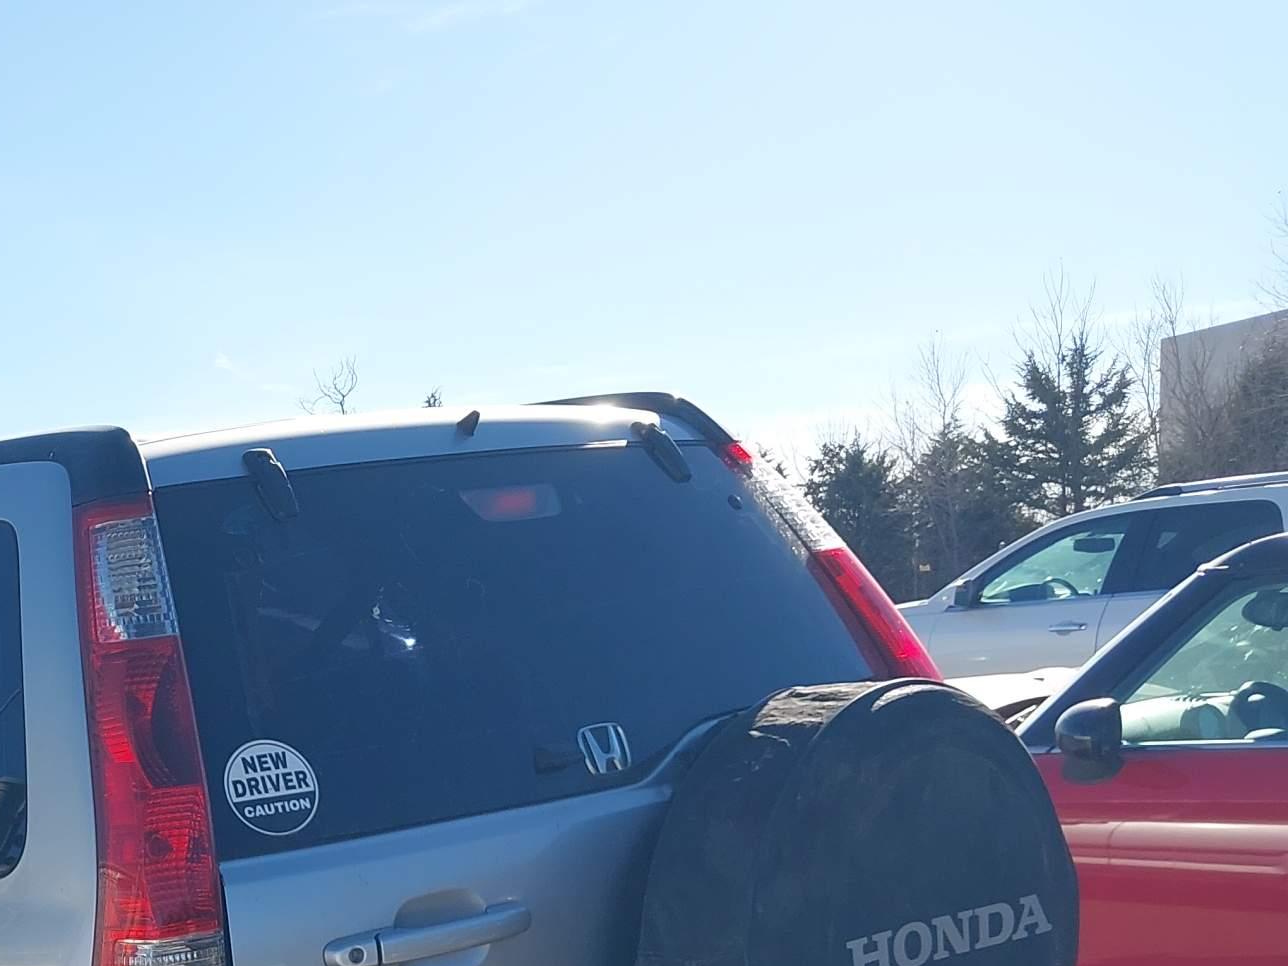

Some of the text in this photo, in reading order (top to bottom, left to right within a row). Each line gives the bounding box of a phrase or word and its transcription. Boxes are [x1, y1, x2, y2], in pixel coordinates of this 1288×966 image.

[241, 751, 288, 774] NEW
[232, 770, 311, 798] DRIVER
[244, 798, 311, 818] CAUTION
